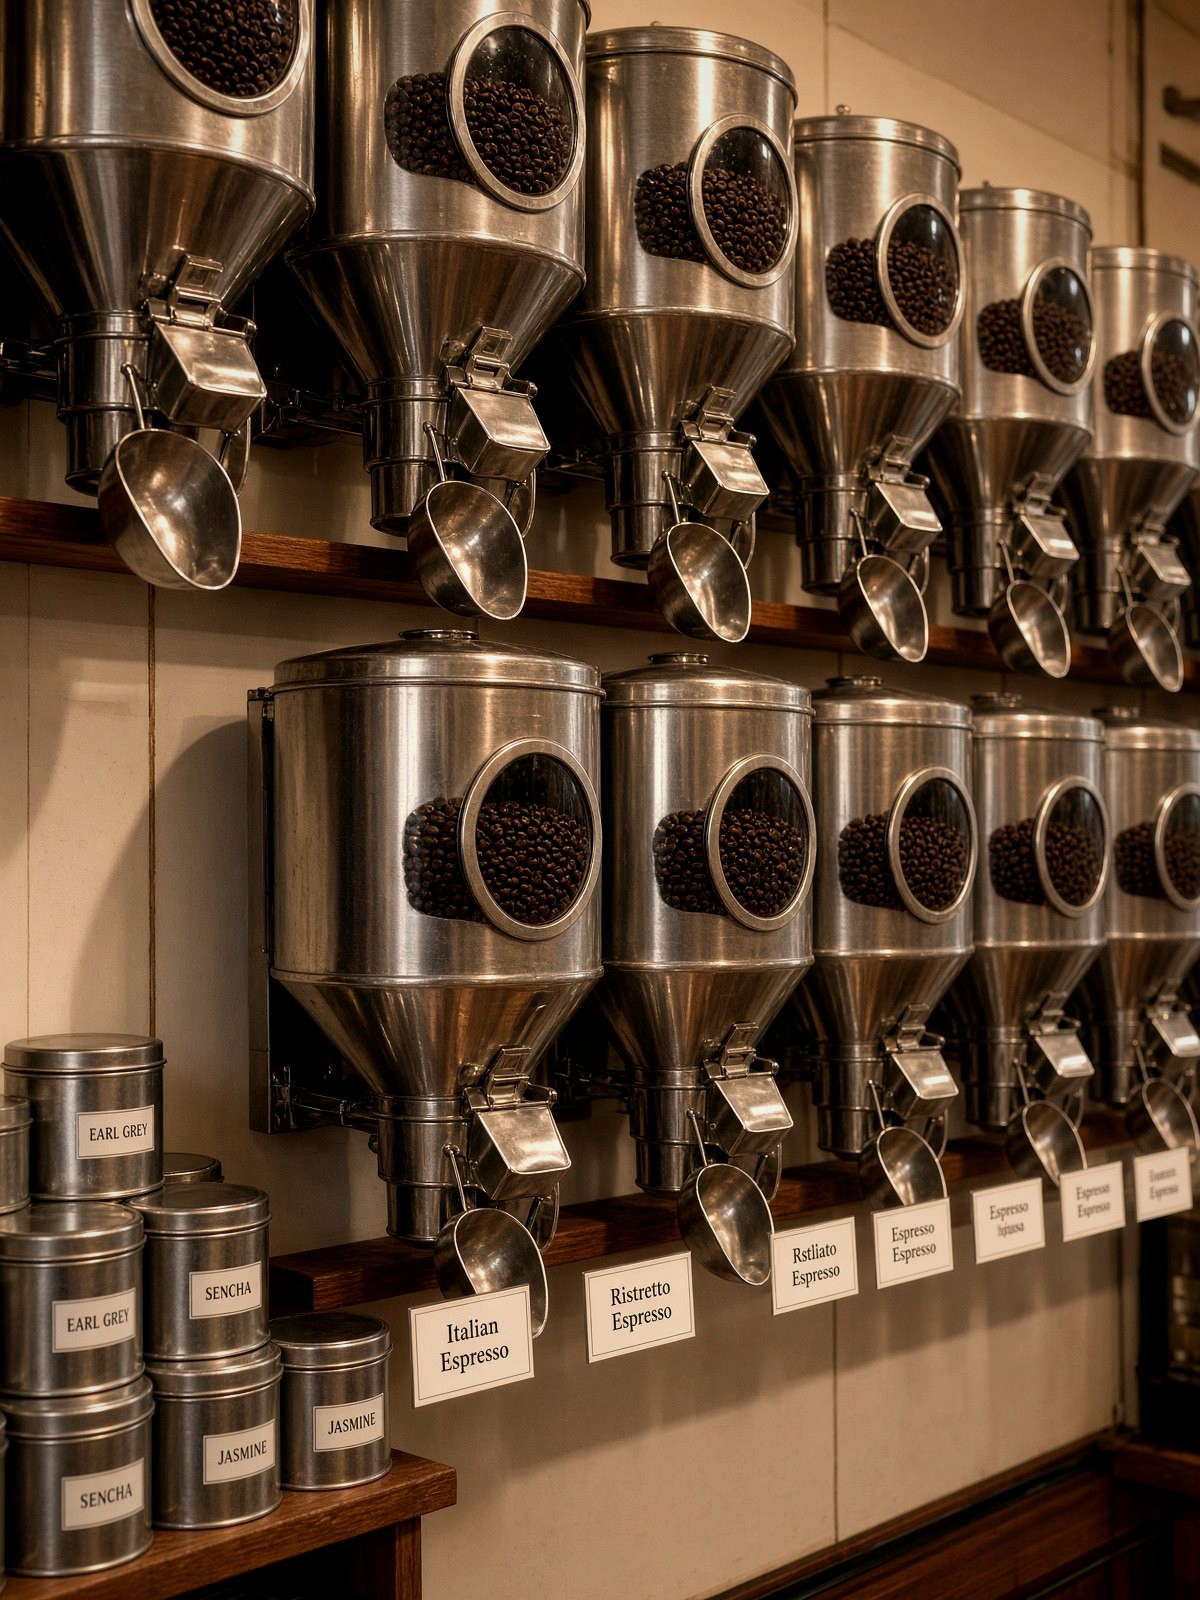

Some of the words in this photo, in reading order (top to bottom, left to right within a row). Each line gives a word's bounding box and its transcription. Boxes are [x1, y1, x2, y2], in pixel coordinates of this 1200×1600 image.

[89, 1126, 120, 1142] EARL
[122, 1123, 148, 1140] GREY
[990, 1202, 1029, 1221] Espresso
[891, 1223, 935, 1244] Espresso
[793, 1243, 837, 1264] Rstliato
[892, 1243, 937, 1264] Espresso
[792, 1265, 840, 1288] Espresso
[205, 1281, 251, 1301] SENCHA
[611, 1281, 671, 1306] Ristretto
[67, 1315, 99, 1333] EARL
[103, 1308, 129, 1328] GREY
[447, 1318, 499, 1343] Italian
[612, 1304, 672, 1332] Espresso
[440, 1344, 509, 1374] Espresso
[328, 1411, 376, 1436] JASMINE
[217, 1440, 267, 1466] JASMINE
[80, 1483, 133, 1509] SENCHA
